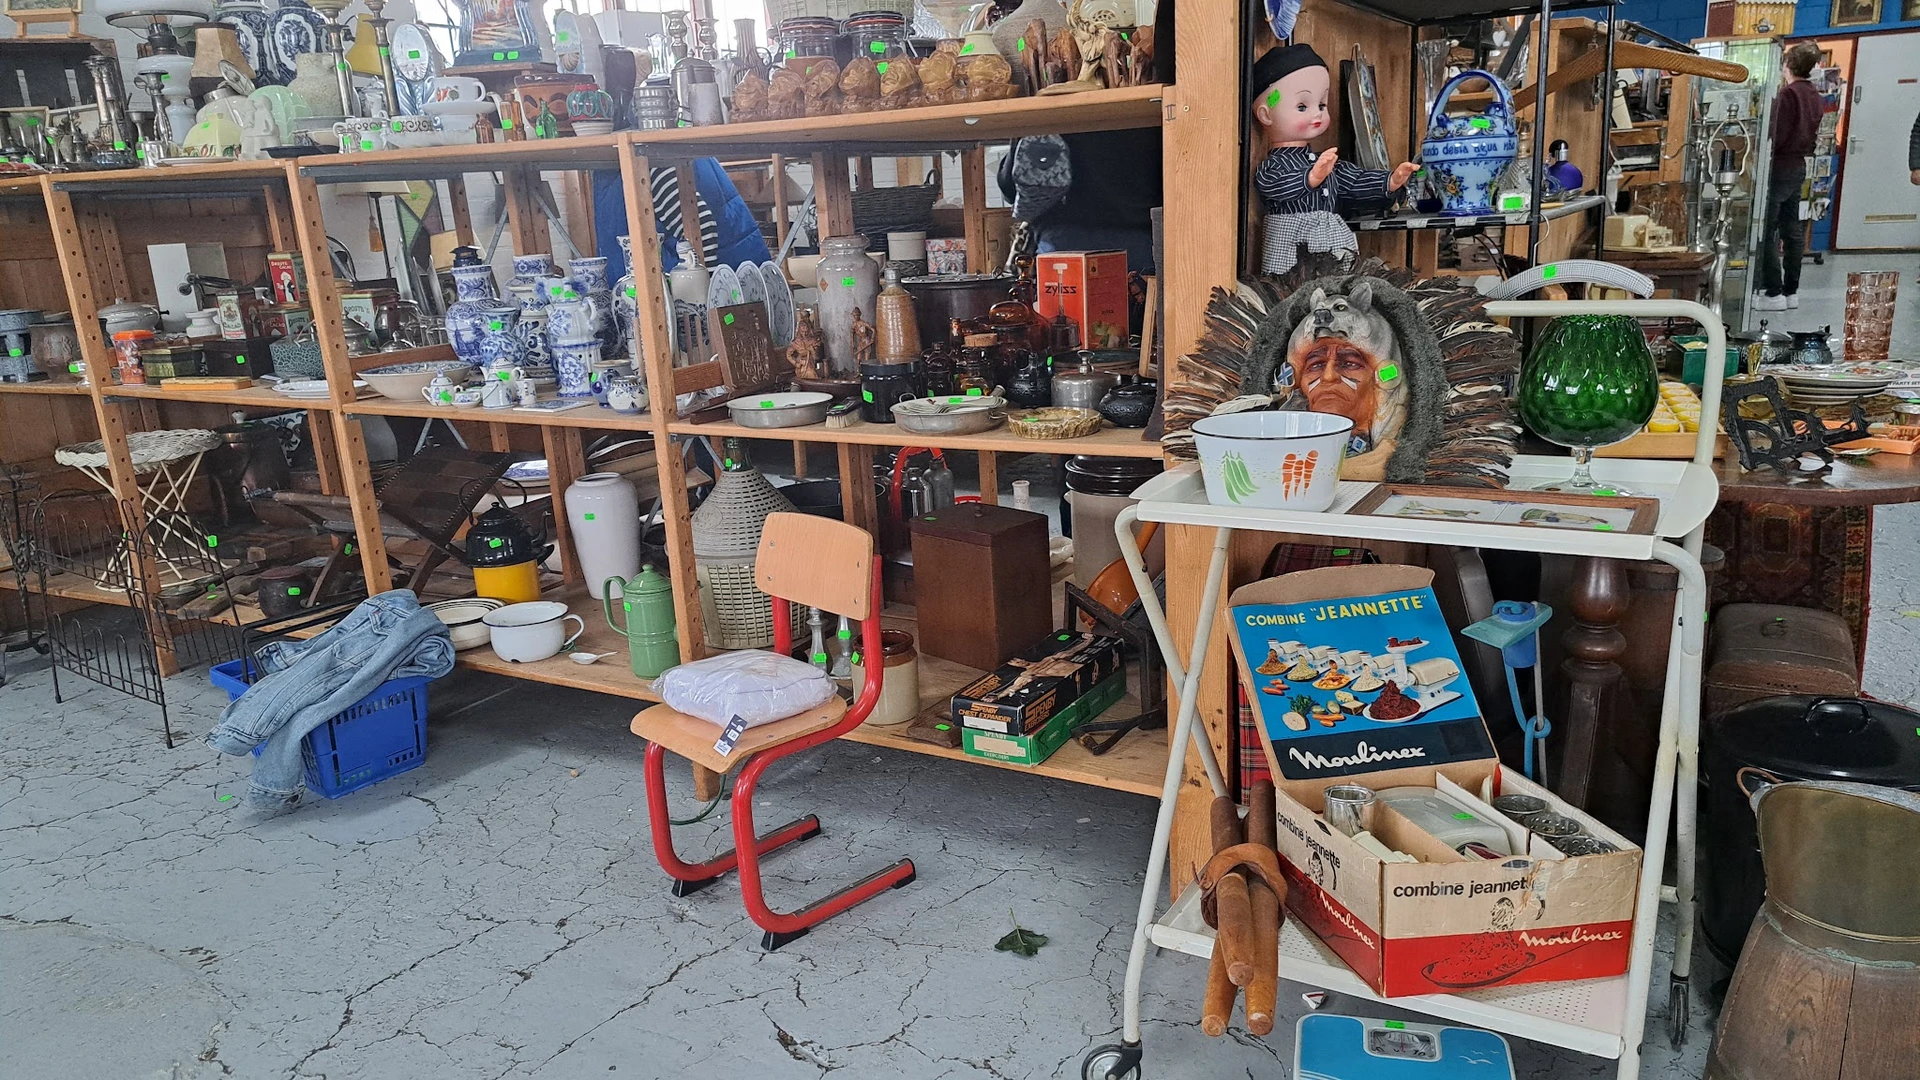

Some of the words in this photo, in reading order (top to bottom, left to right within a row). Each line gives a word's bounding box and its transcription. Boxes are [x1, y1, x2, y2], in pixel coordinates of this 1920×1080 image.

[1044, 283, 1077, 296] zyliss
[958, 708, 978, 717] CHEST
[979, 712, 1012, 723] EXPANDER
[1289, 741, 1426, 770] Moulinex
[1319, 890, 1376, 950] Moulinex
[1518, 927, 1624, 947] Moulinex
